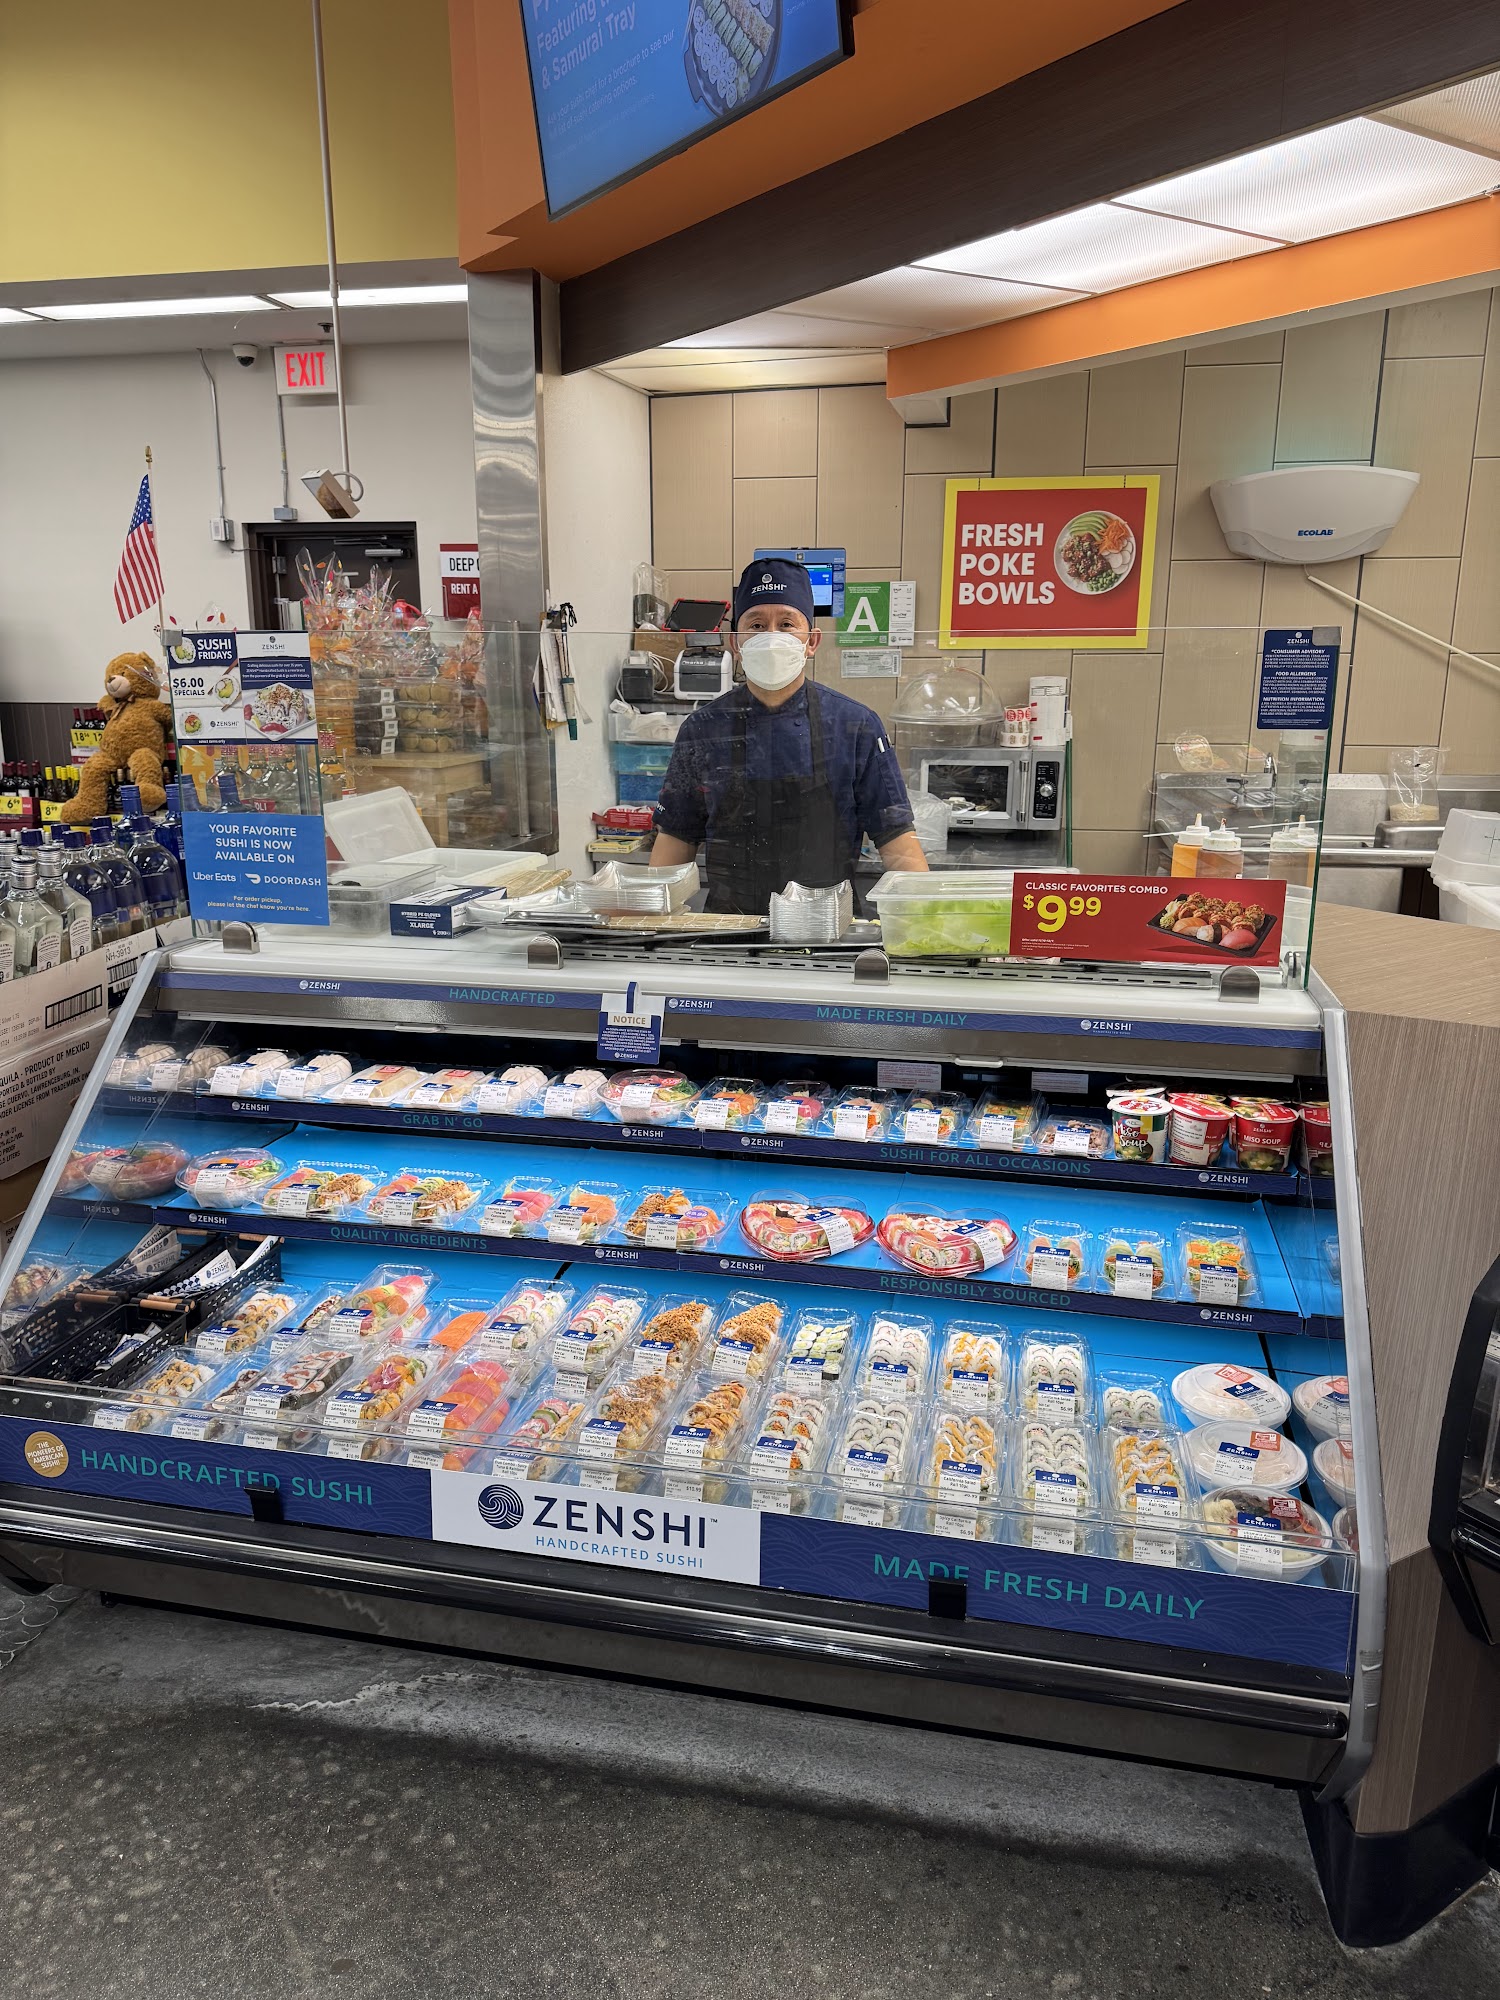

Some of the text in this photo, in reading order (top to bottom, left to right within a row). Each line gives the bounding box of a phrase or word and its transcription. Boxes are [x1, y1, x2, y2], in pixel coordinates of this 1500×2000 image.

[536, 1, 597, 58] Featuring
[541, 66, 551, 90] &
[552, 25, 603, 81] Samurai
[606, 2, 636, 40] Tray
[585, 82, 598, 99] chef
[598, 75, 608, 88] for
[612, 54, 641, 81] brochure
[641, 47, 648, 60] to
[650, 40, 662, 54] see
[662, 28, 675, 44] our
[587, 93, 613, 115] catering
[613, 78, 638, 97] options.
[285, 352, 326, 387] EXIT
[961, 523, 1044, 547] FRESH
[449, 557, 475, 571] DEEP
[960, 552, 1035, 577] POKE
[450, 583, 478, 595] RENT A
[752, 584, 786, 594] ZENSHI
[958, 581, 1055, 605] BOWLS
[846, 597, 879, 632] A
[196, 638, 232, 650] SUSHI
[197, 651, 233, 660] FRIDAYS
[172, 677, 204, 688] $6.00
[216, 720, 239, 728] ZENSHI
[209, 824, 297, 837] YOUR FAVORITE
[215, 837, 292, 850] SUSHI IS NOW
[215, 851, 295, 864] AVAILABLE ON
[192, 871, 322, 886] Uber Eats DOORDASH
[1025, 881, 1169, 895] CLASSIC FAVORITES COMBO
[261, 896, 283, 904] pickup,
[105, 948, 131, 962] NH-3913
[309, 981, 341, 991] ZENSHI
[449, 988, 556, 1004] HANDCRAFTED
[679, 998, 714, 1010] ZENSHI
[613, 1015, 646, 1025] NOTICE
[816, 1006, 968, 1026] MADE FRESH DAILY
[1092, 1021, 1133, 1032] ZENSHI
[24, 1041, 90, 1076] PRODUCT OF MEXICO
[20, 1081, 26, 1089] &
[26, 1071, 48, 1086] BOTTLED
[48, 1067, 56, 1076] BY
[72, 1067, 81, 1076] IN.
[13, 1077, 81, 1113] LICENSE FROM TRADEMARK
[241, 1102, 270, 1112] ZENSHI
[403, 1113, 440, 1127] GRAB
[462, 1117, 483, 1128] GO
[632, 1129, 664, 1138] ZENSHI
[1113, 1121, 1139, 1137] Miso
[751, 1138, 784, 1147] ZENSHI
[1119, 1135, 1147, 1153] Soup
[1243, 1135, 1261, 1145] MISO
[2, 1144, 16, 1155] PROOF
[6, 1151, 21, 1163] LITERS
[880, 1148, 1091, 1174] SUSHI FOR ALL OCCASIONS
[1210, 1174, 1250, 1184] ZENSHI
[198, 1215, 227, 1225] ZENSHI
[330, 1226, 488, 1250] QUALITY INGREDIENTS
[605, 1249, 639, 1260] ZENSHI
[211, 1261, 230, 1276] ZENSHI
[730, 1261, 764, 1271] ZENSHI
[880, 1275, 1071, 1306] RESPONSIBLY SOURCED
[1213, 1310, 1253, 1323] ZENSHI
[725, 1342, 751, 1350] ZENSHI
[27, 1444, 64, 1459] PIONEERS OF
[36, 1441, 50, 1449] THE
[763, 1441, 791, 1449] ZENSHI
[33, 1452, 64, 1464] AMERICAN
[81, 1449, 373, 1506] HANDCRAFTED SUSHI
[1245, 1518, 1275, 1528] ZENSHI
[536, 1536, 704, 1568] HANDCRAFTED SUSHI
[874, 1554, 1205, 1620] MADE FRESH DAILY
